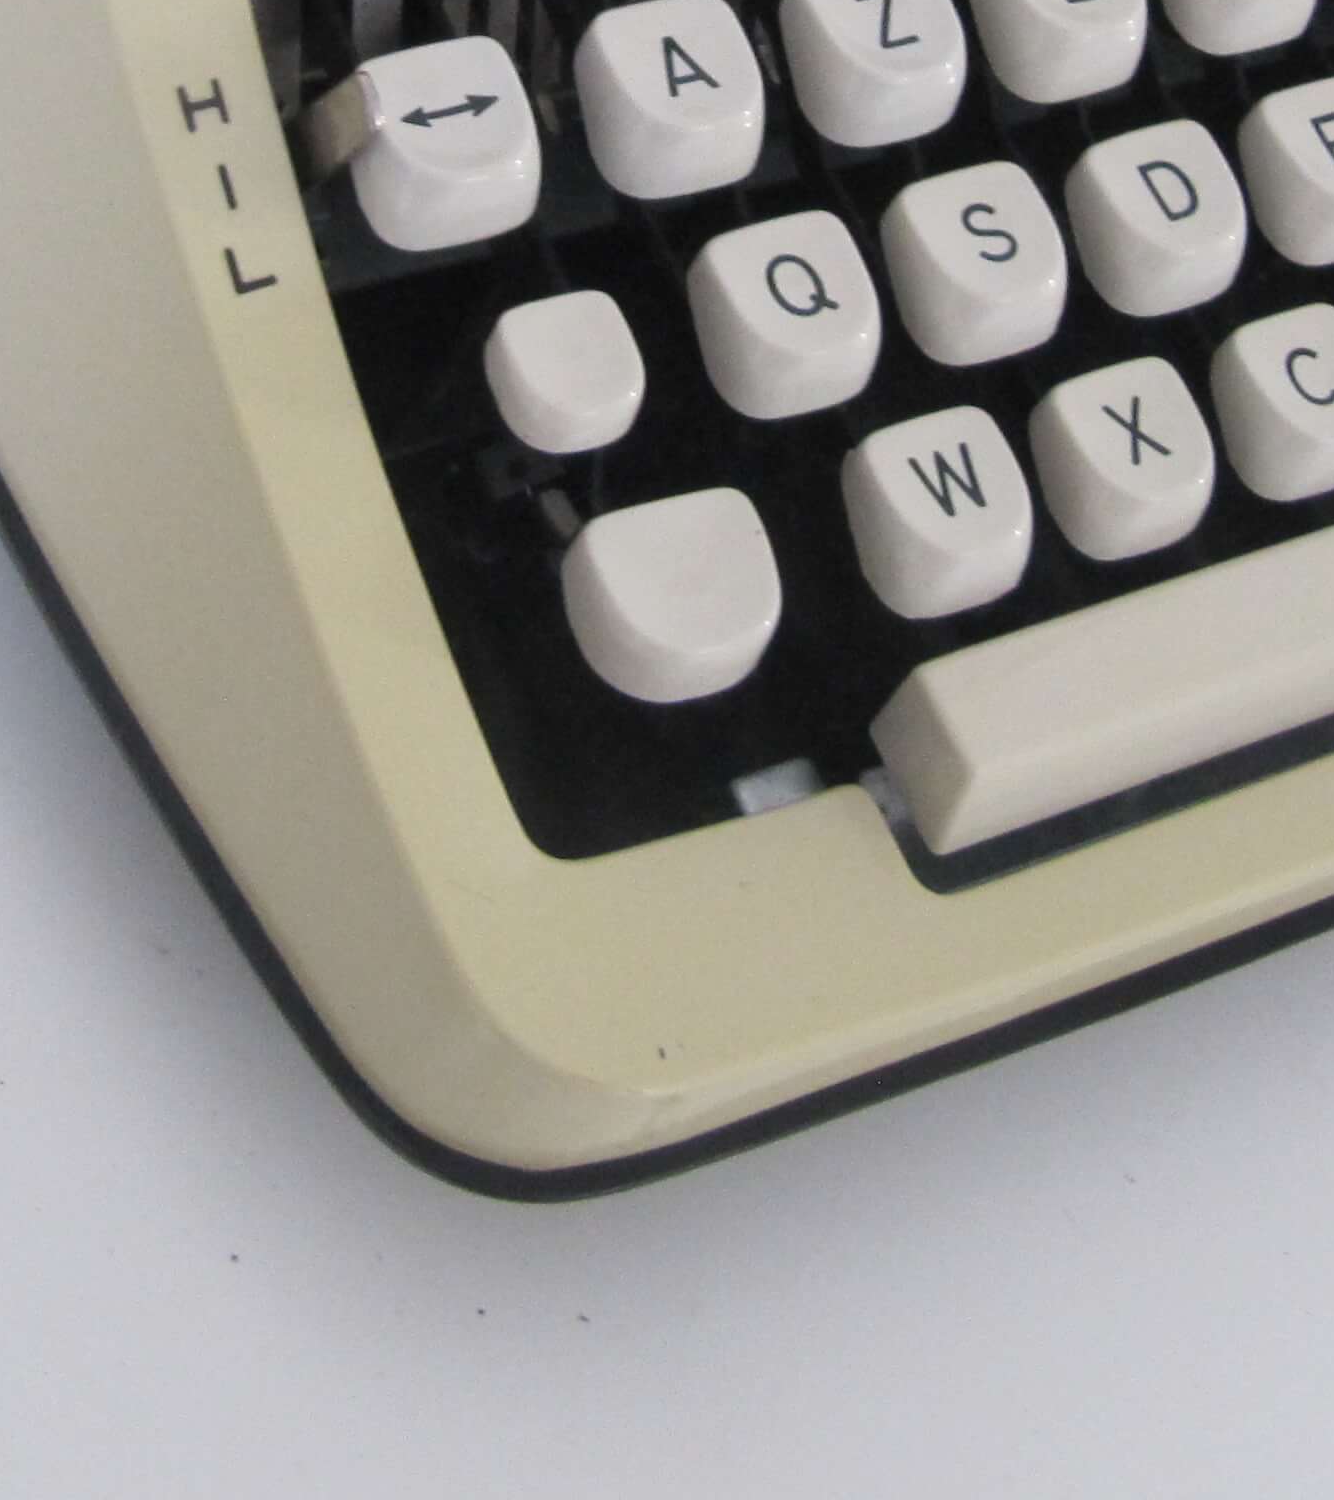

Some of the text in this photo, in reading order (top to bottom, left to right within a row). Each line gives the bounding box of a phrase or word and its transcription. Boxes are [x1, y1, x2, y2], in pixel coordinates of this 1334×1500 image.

[662, 36, 720, 98] A
[765, 254, 839, 317] Q
[961, 203, 1018, 263] S
[1137, 160, 1199, 222] D
[908, 442, 987, 517] W
[1102, 395, 1172, 466] X
